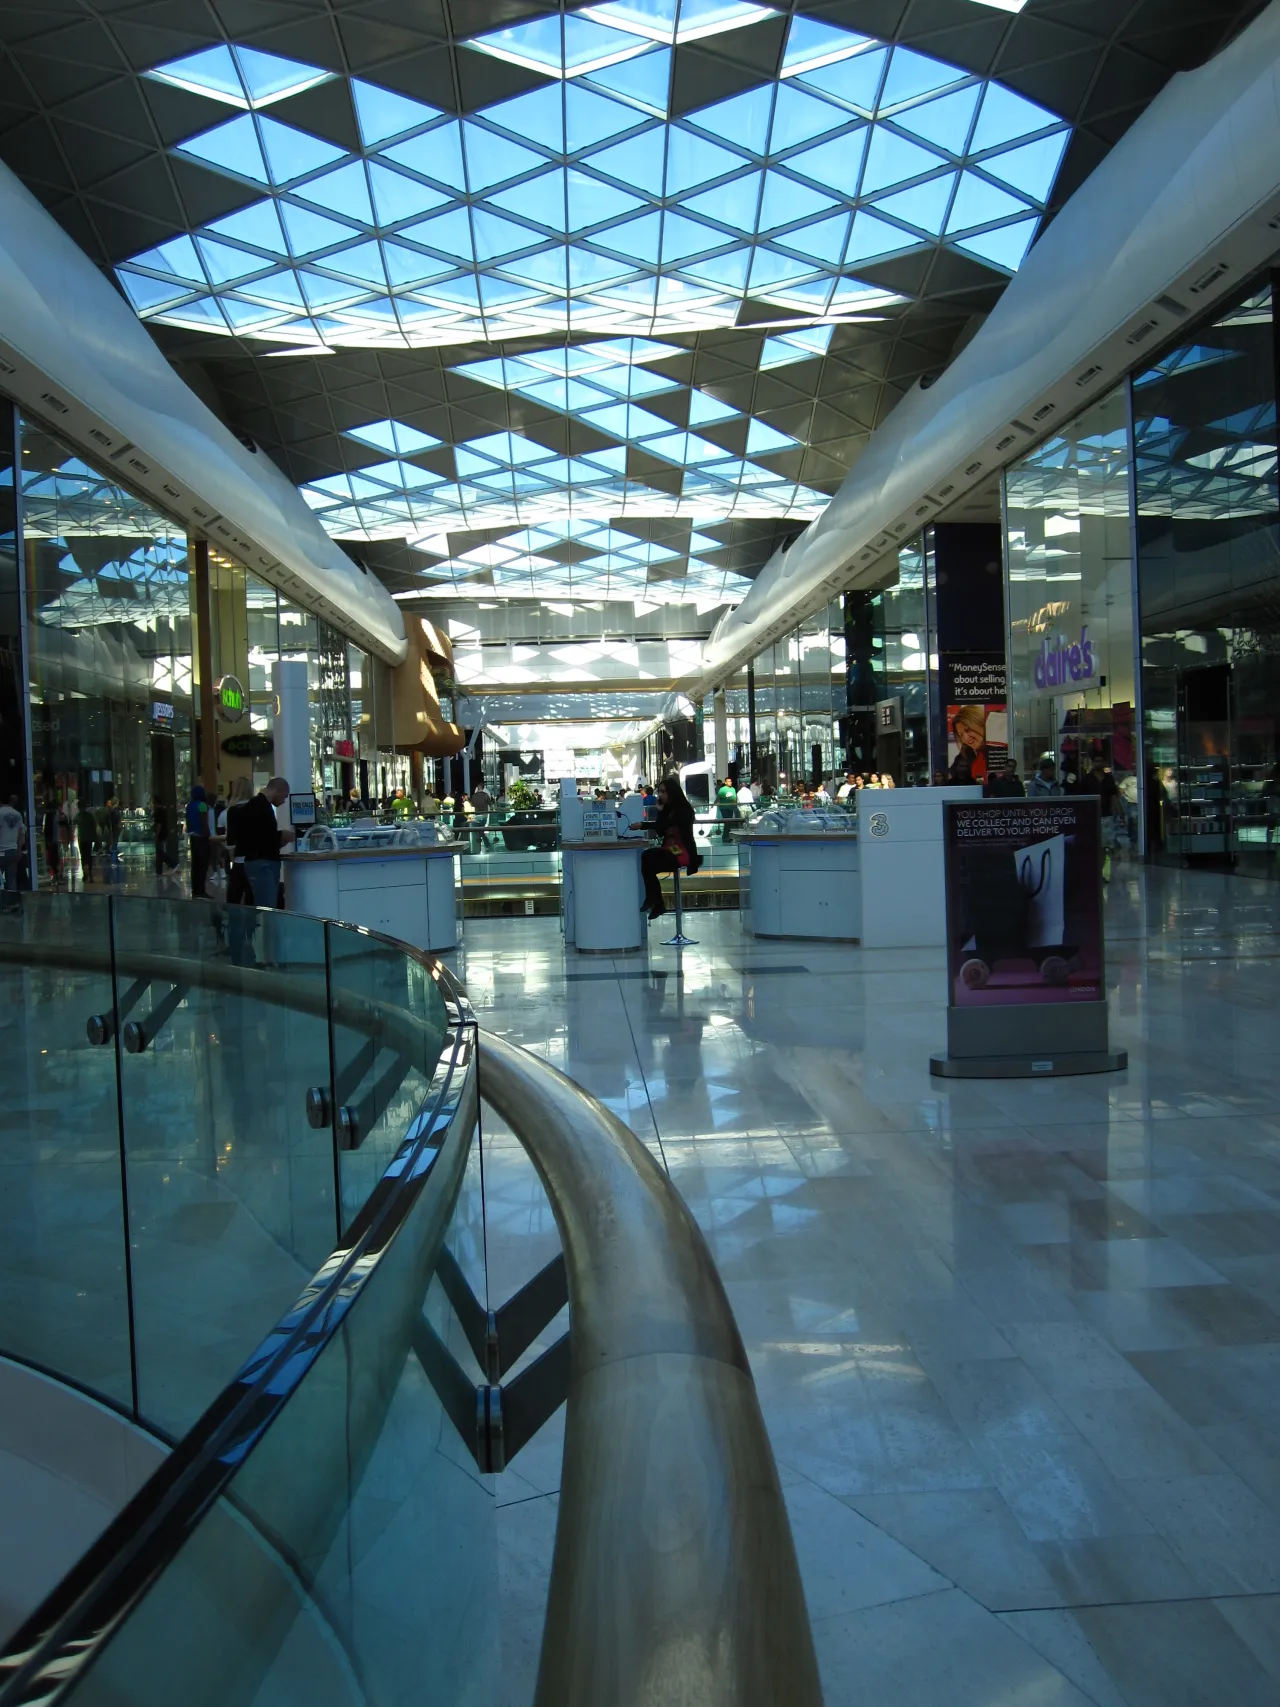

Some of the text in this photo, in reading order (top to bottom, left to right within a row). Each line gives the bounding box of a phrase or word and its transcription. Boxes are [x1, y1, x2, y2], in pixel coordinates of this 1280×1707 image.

[954, 674, 1005, 685] about selling
[955, 686, 968, 695] it's
[969, 686, 993, 695] about
[957, 808, 1073, 819] YOU SHOP UNTIL YOU DROP
[957, 816, 1076, 828] WE COLLECT AND CAN EVEN
[957, 826, 1060, 837] DELIVER TO YOUR HOME
[1070, 986, 1096, 994] LONDON
